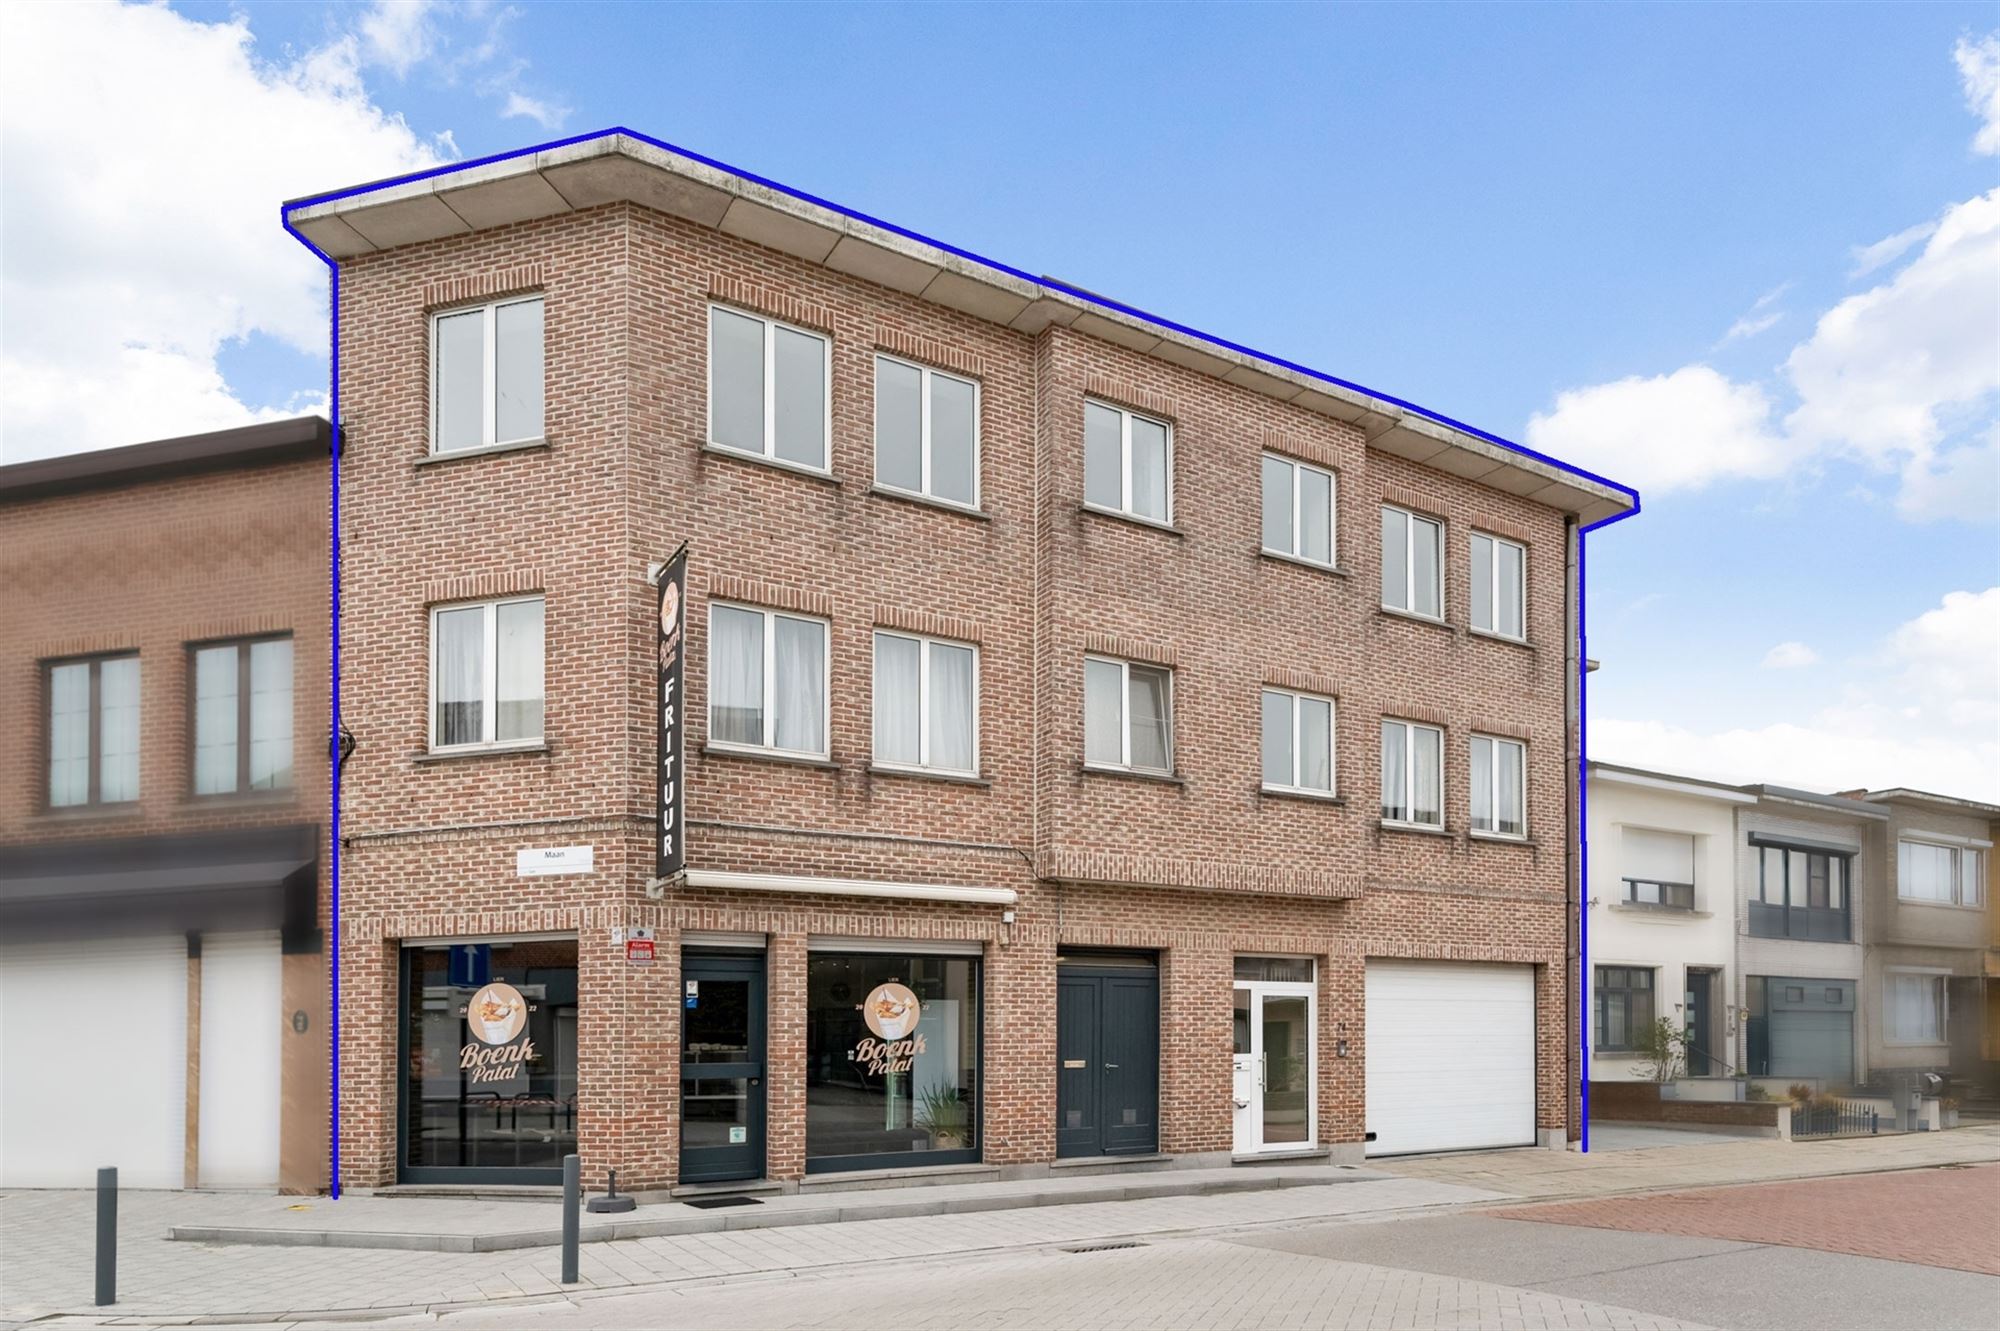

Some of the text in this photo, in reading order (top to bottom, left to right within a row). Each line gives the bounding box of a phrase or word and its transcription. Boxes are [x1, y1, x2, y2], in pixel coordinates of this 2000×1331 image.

[663, 677, 675, 858] FRITUUR
[544, 851, 565, 859] Maan
[460, 1037, 536, 1068] Boenk
[856, 1033, 927, 1062] Boenk
[472, 1063, 519, 1084] Patat
[868, 1057, 914, 1076] Patat
